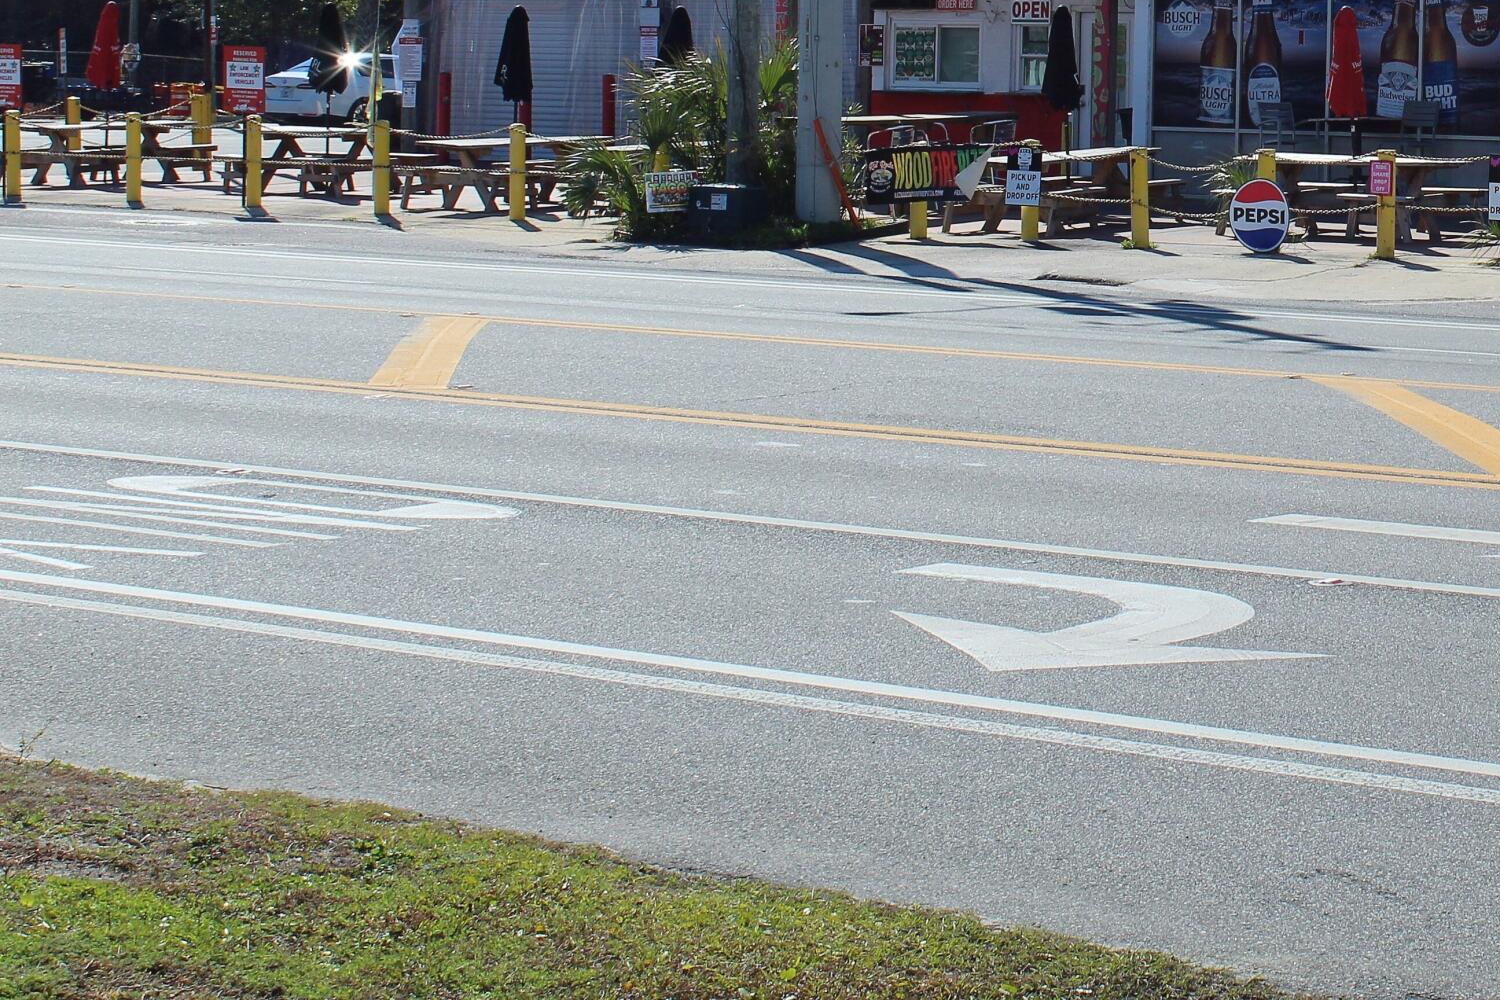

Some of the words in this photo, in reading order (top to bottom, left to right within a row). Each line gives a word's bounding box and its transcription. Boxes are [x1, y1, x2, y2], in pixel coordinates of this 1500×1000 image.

[938, 0, 957, 9] ORDER
[958, 0, 974, 9] HERE
[1012, 1, 1049, 18] OPEN
[1164, 11, 1200, 24] BUSCH
[1171, 24, 1193, 32] LIGHT
[1200, 86, 1233, 103] BUSCH
[1248, 90, 1280, 100] ULTRA
[1425, 84, 1453, 98] BUD
[1205, 101, 1228, 110] LIGHT
[892, 151, 932, 190] WOOD
[931, 150, 957, 188] FIRE
[1011, 173, 1025, 181] PICK
[1006, 191, 1025, 199] DROP
[1233, 206, 1286, 225] PEPSI
